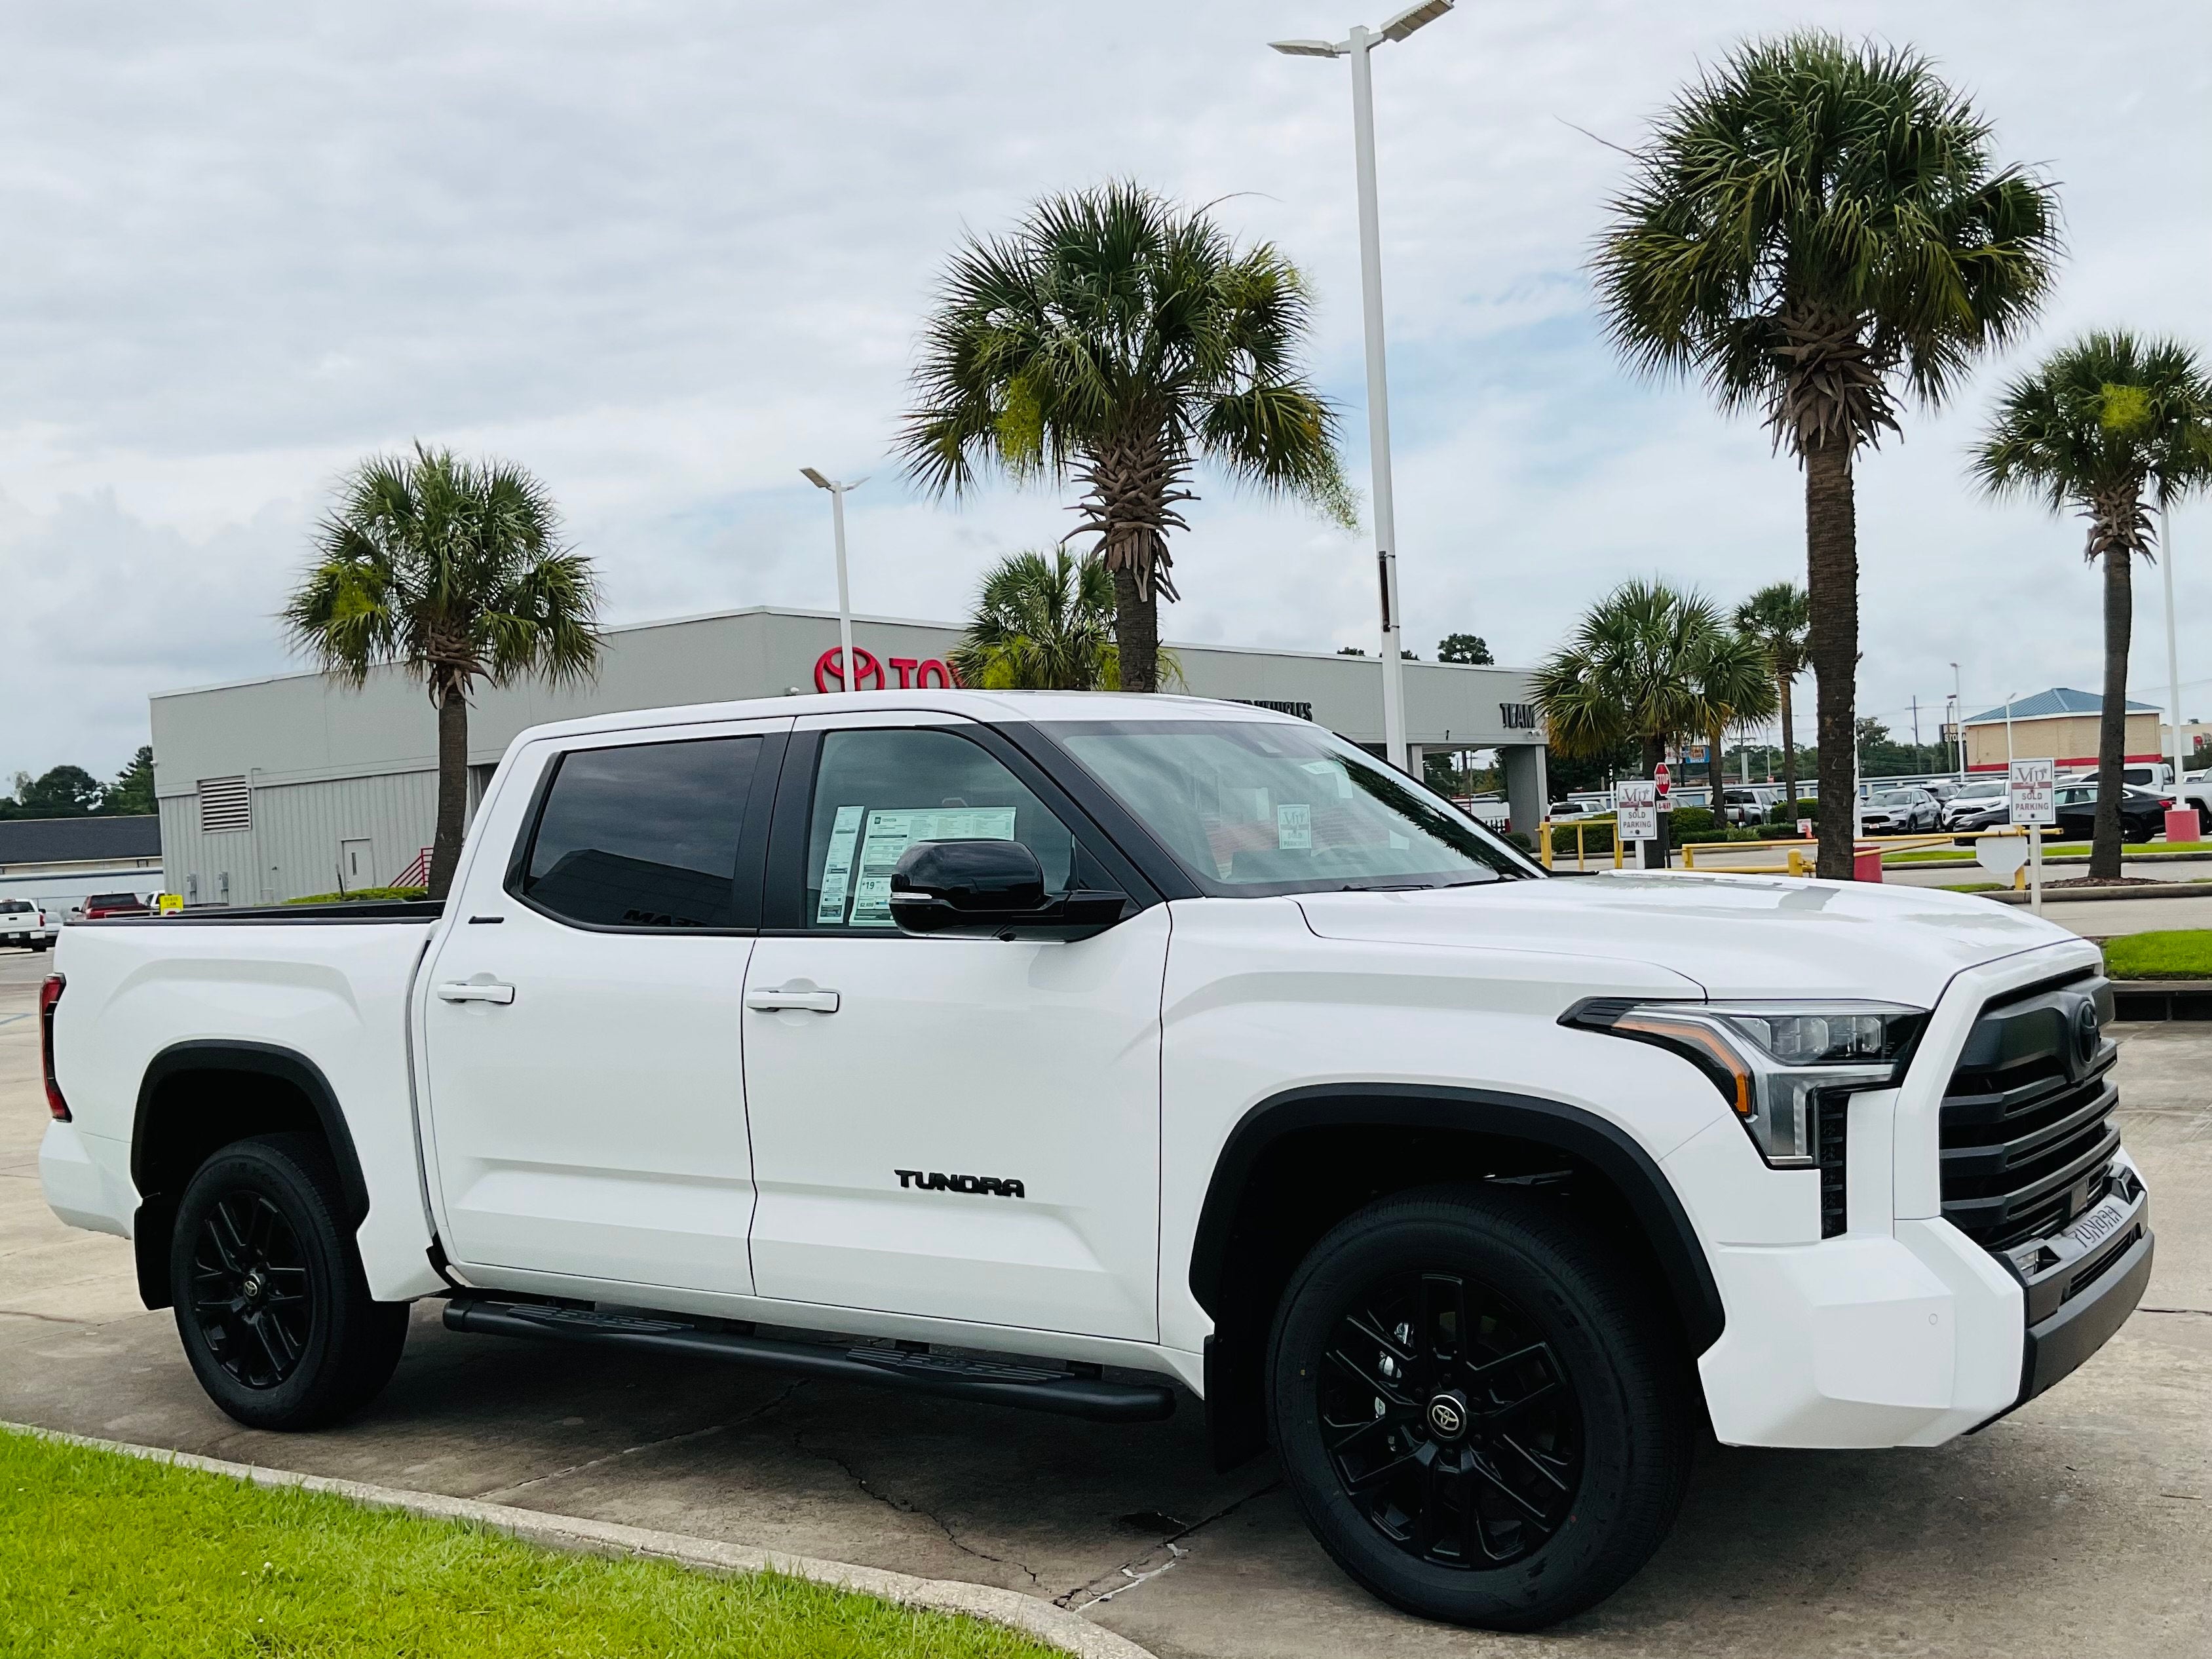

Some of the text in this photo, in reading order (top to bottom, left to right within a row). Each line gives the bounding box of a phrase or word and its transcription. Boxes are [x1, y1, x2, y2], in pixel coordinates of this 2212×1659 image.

[1499, 703, 1536, 728] TEAM
[1656, 773, 1669, 785] STOP
[866, 881, 875, 890] 19
[894, 1170, 1025, 1198] TUNDRA
[2066, 1205, 2123, 1248] TUNDRA
